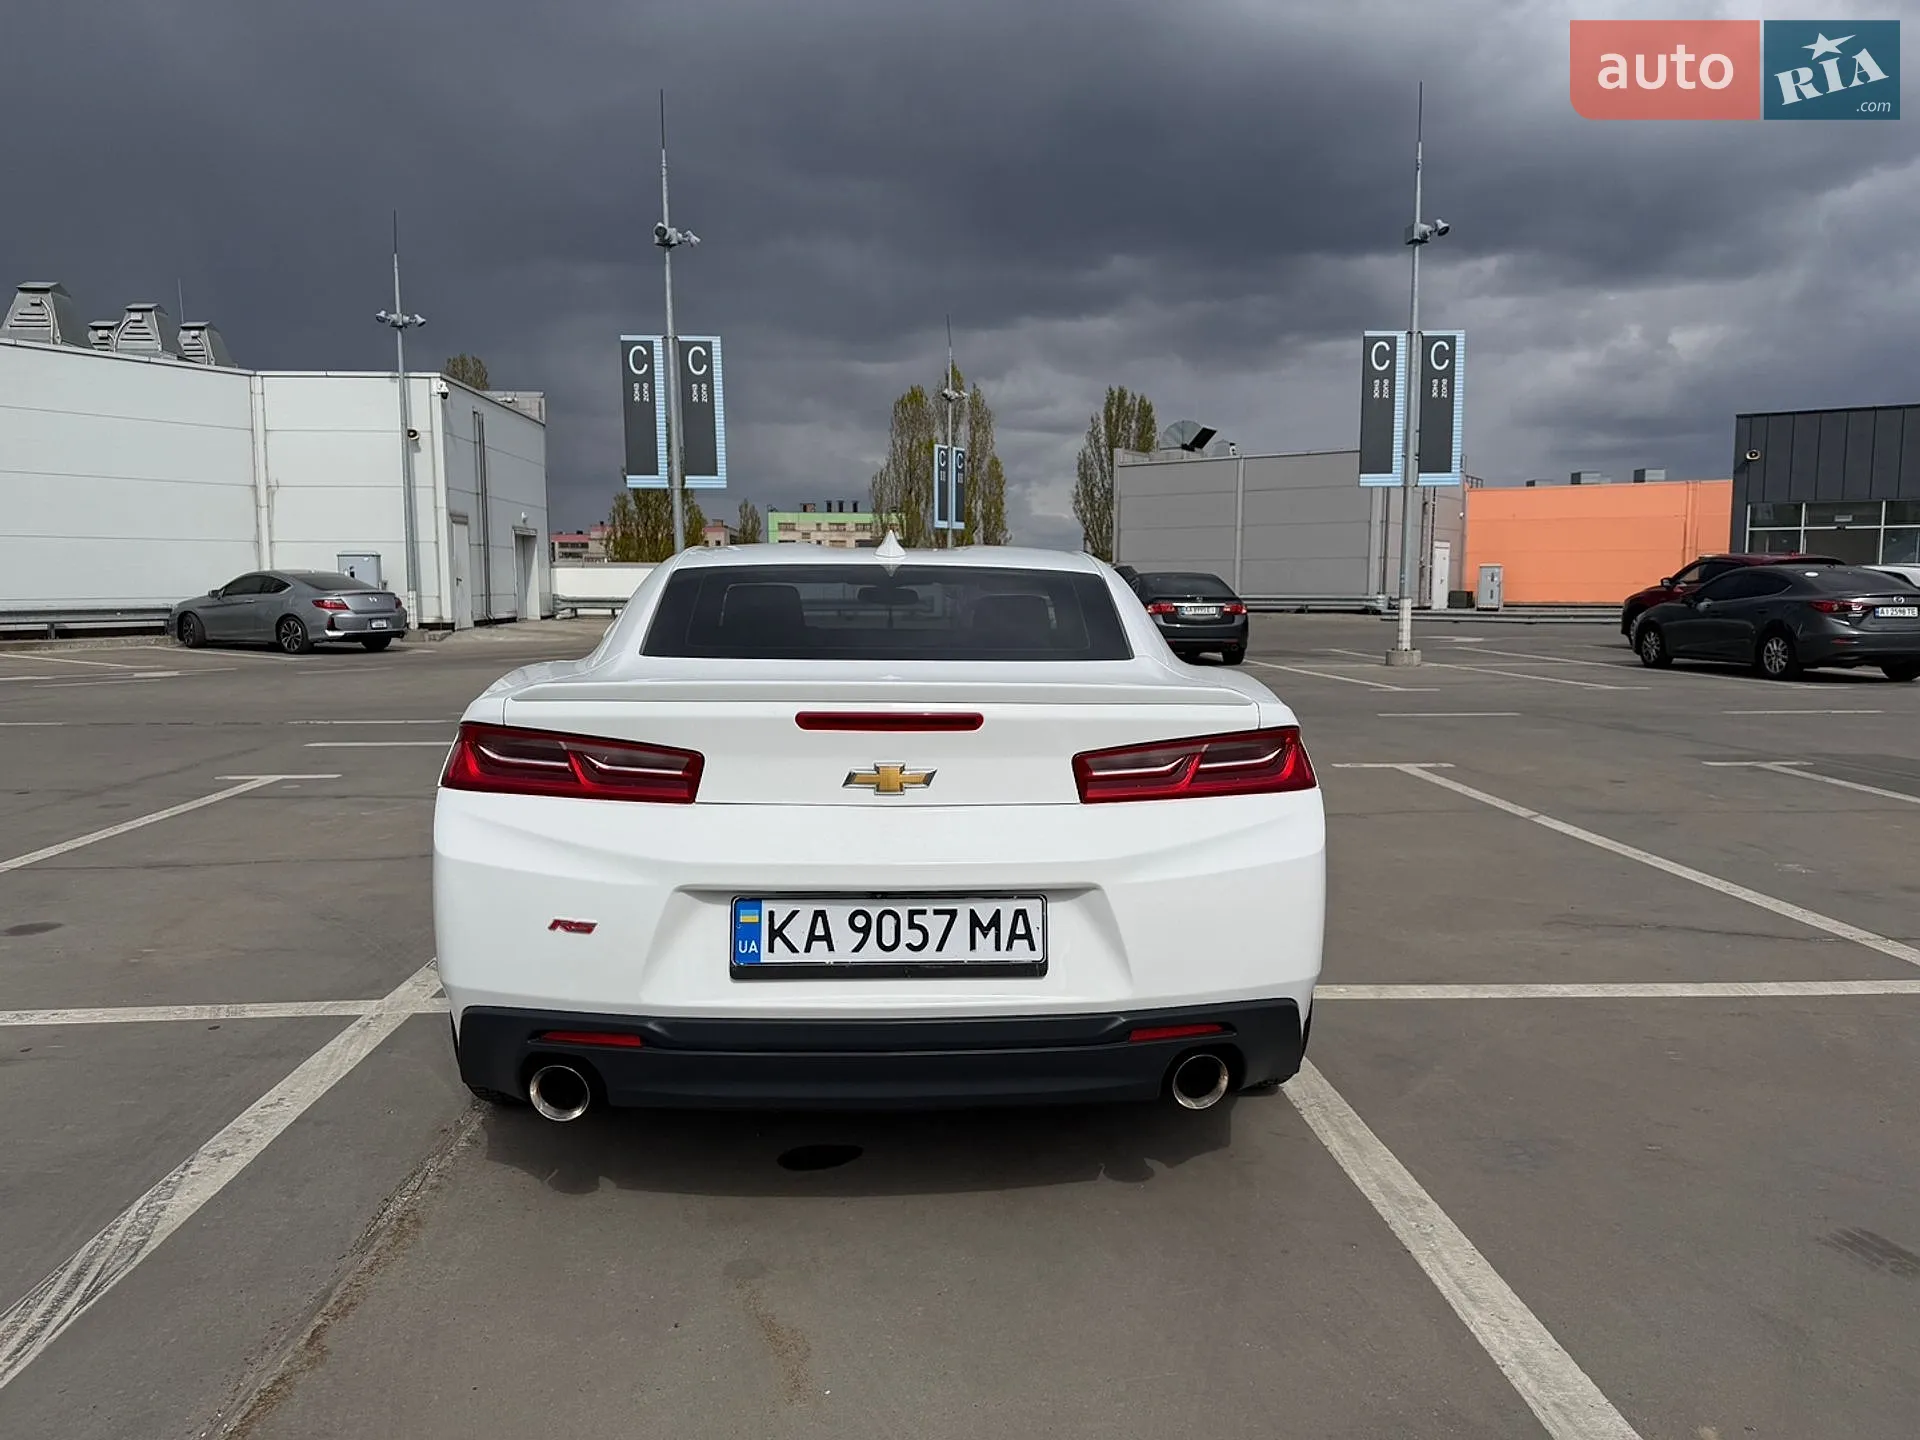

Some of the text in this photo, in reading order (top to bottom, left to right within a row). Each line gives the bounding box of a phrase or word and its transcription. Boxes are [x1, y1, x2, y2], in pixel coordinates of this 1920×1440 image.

[629, 345, 648, 374] C
[688, 346, 707, 375] C
[1371, 341, 1390, 371] C
[1430, 341, 1449, 371] C
[548, 919, 598, 935] RS
[767, 908, 1036, 954] KA 9057 MA
[738, 939, 759, 954] UA
